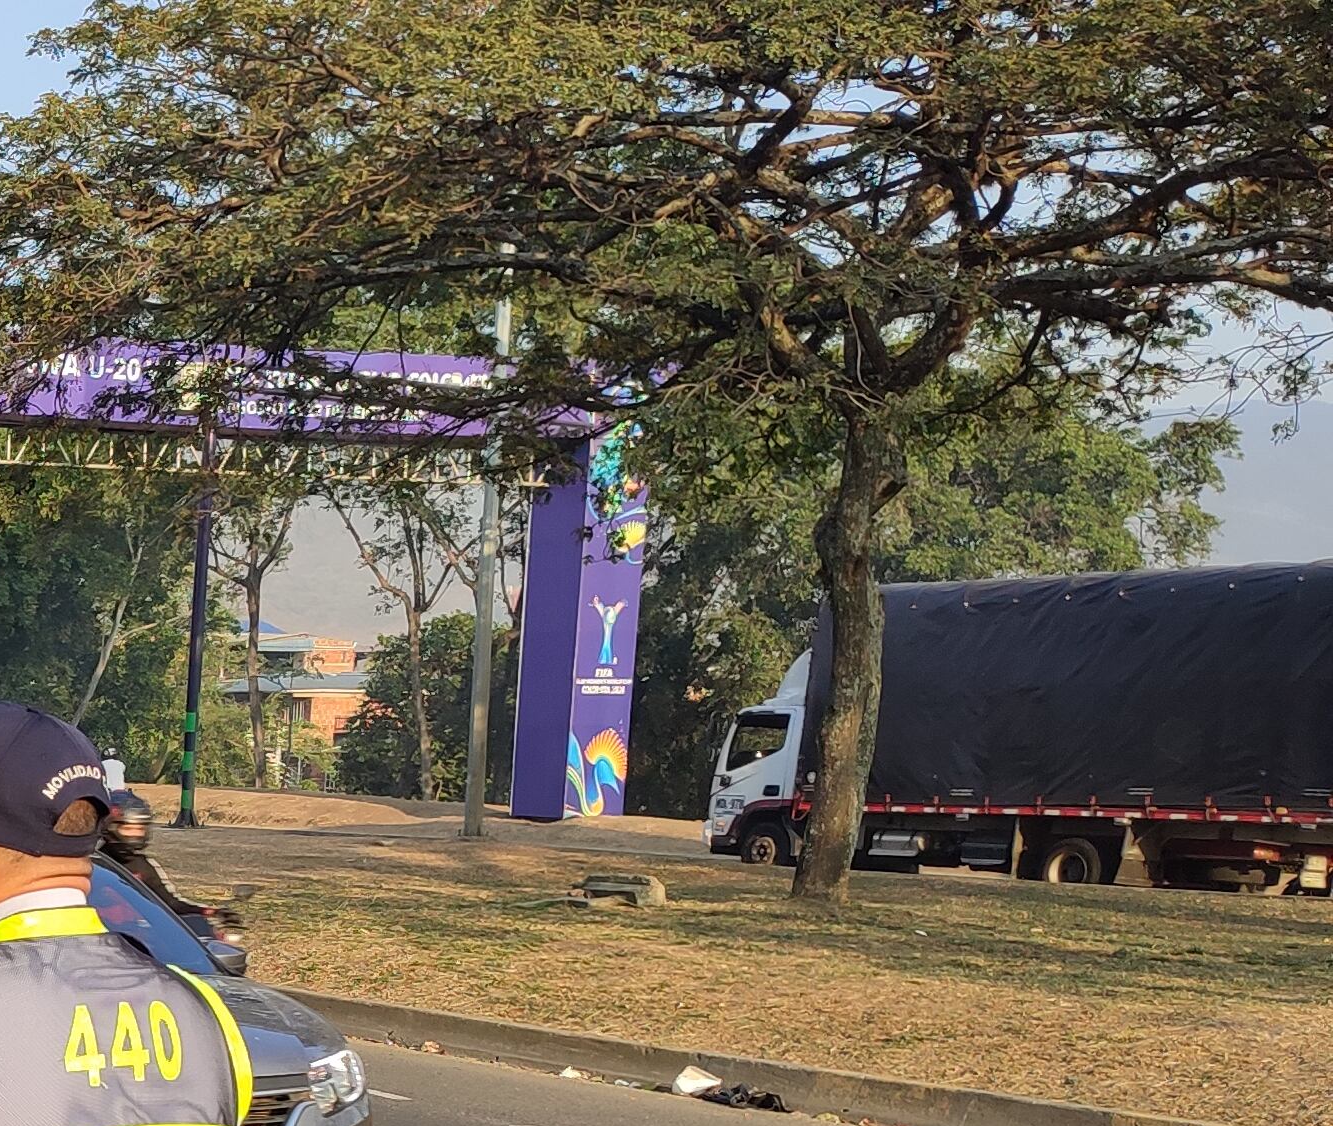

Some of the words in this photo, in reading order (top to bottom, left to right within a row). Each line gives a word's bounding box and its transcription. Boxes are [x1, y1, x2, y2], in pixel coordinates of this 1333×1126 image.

[90, 354, 141, 380] U-20
[42, 763, 102, 800] MOVILIDAD
[64, 1000, 182, 1087] 440
